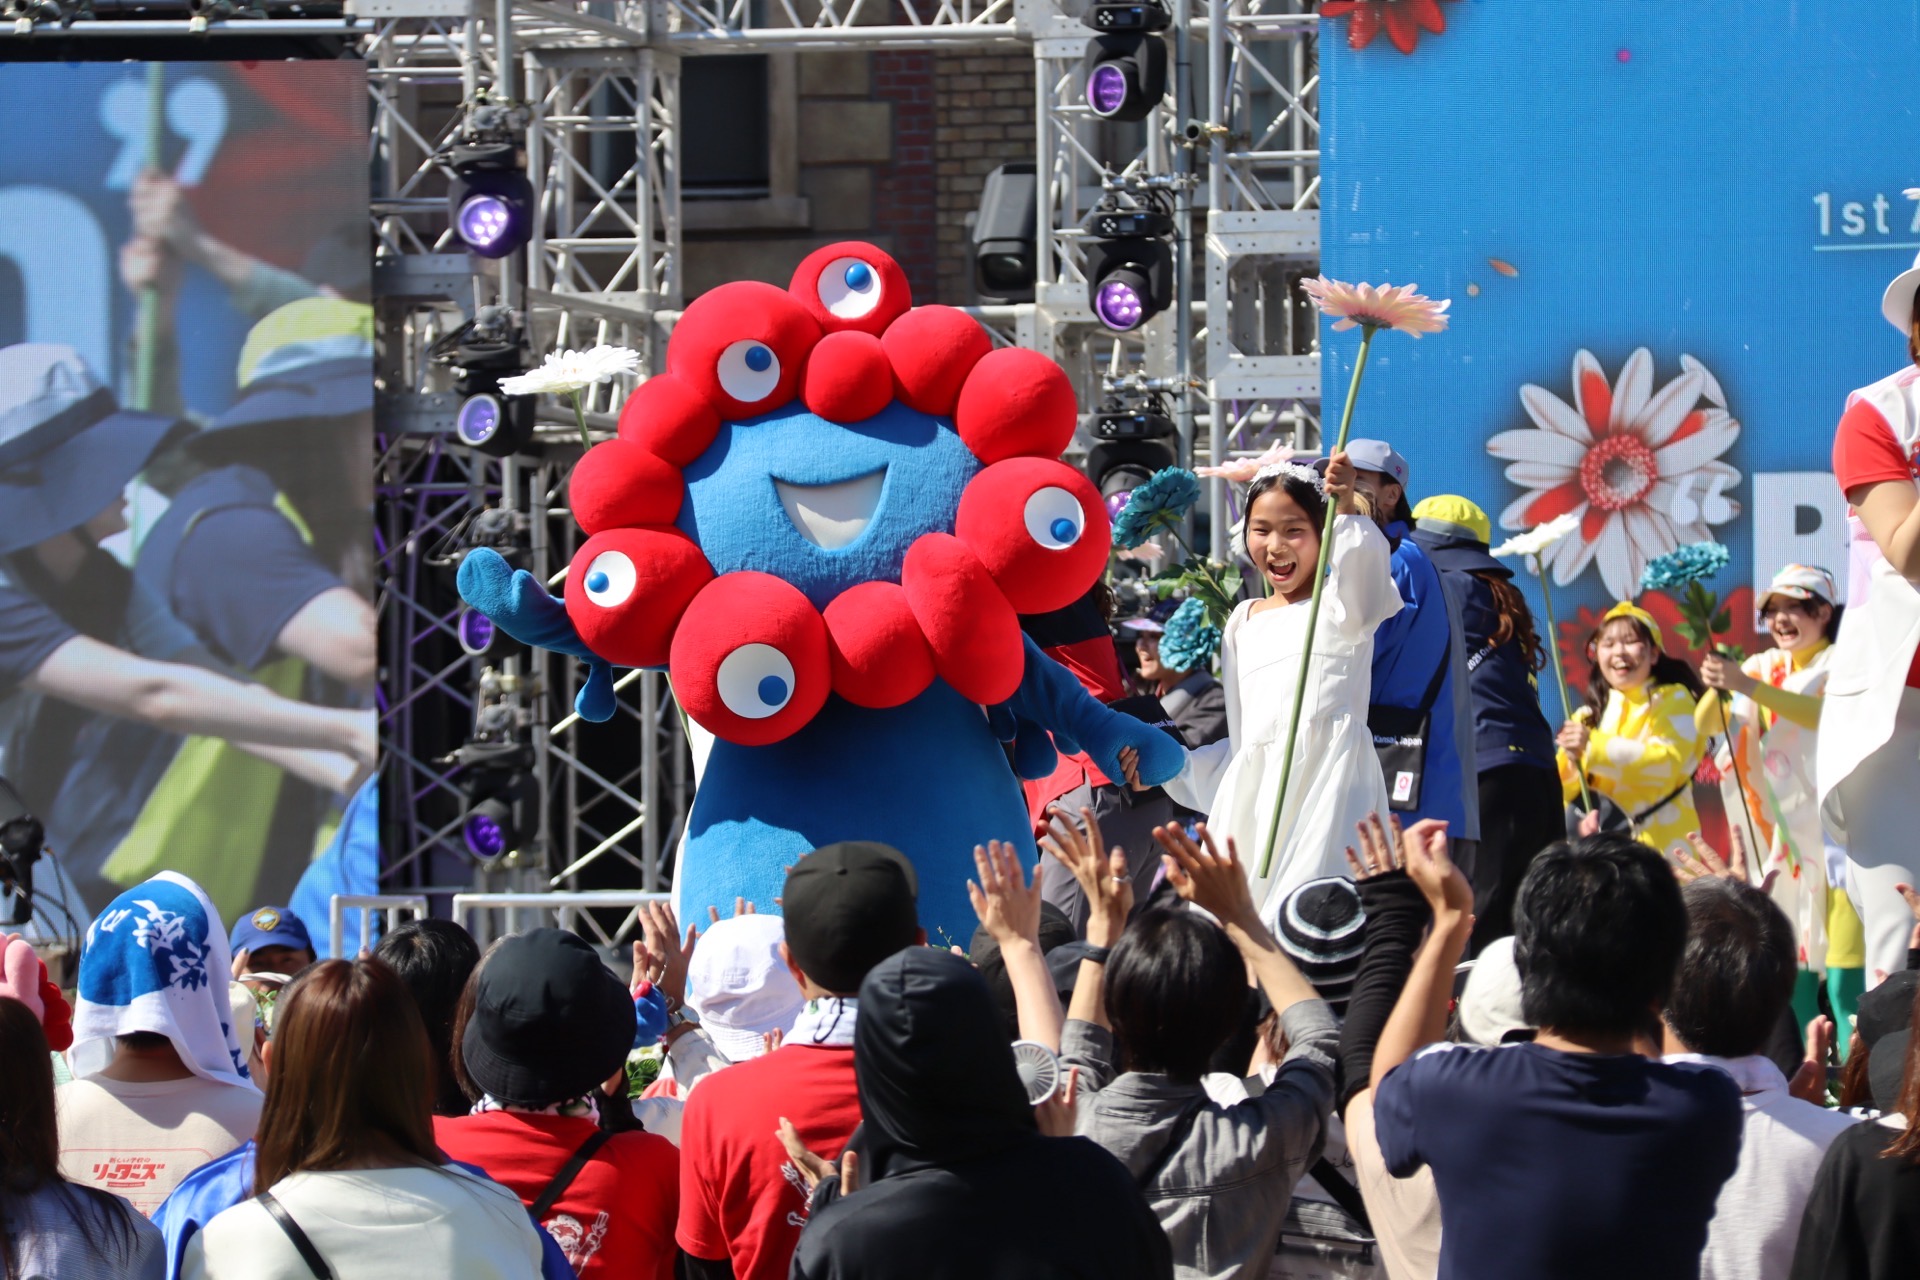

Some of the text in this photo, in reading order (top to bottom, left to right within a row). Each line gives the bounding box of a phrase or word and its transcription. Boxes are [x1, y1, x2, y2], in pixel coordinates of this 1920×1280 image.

[1812, 192, 1889, 236] 1st
[93, 1163, 165, 1180] リーダーズ
